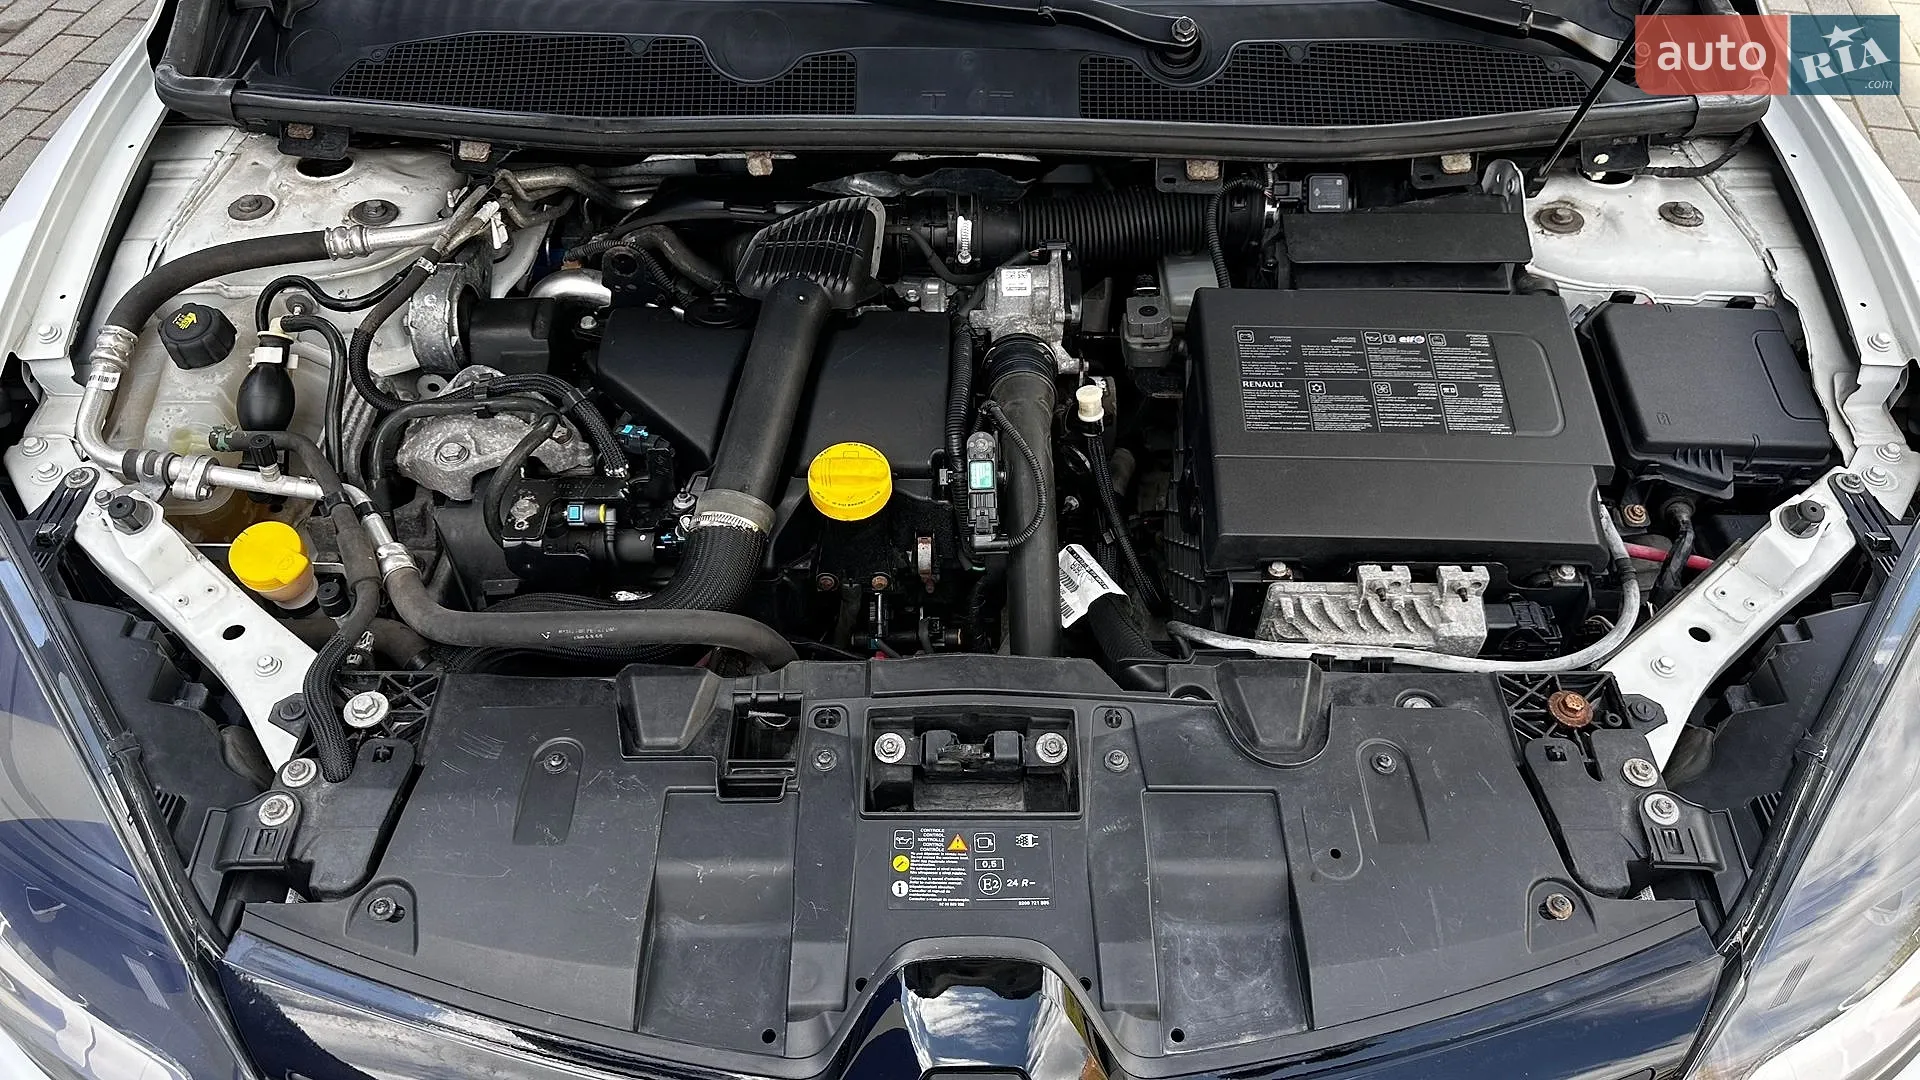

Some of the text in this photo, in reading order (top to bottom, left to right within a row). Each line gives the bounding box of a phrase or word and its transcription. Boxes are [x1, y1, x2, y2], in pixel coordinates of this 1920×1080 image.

[1242, 380, 1284, 388] RENAULT
[981, 860, 997, 869] 0,5
[982, 878, 1000, 891] E2
[1006, 878, 1019, 887] 24
